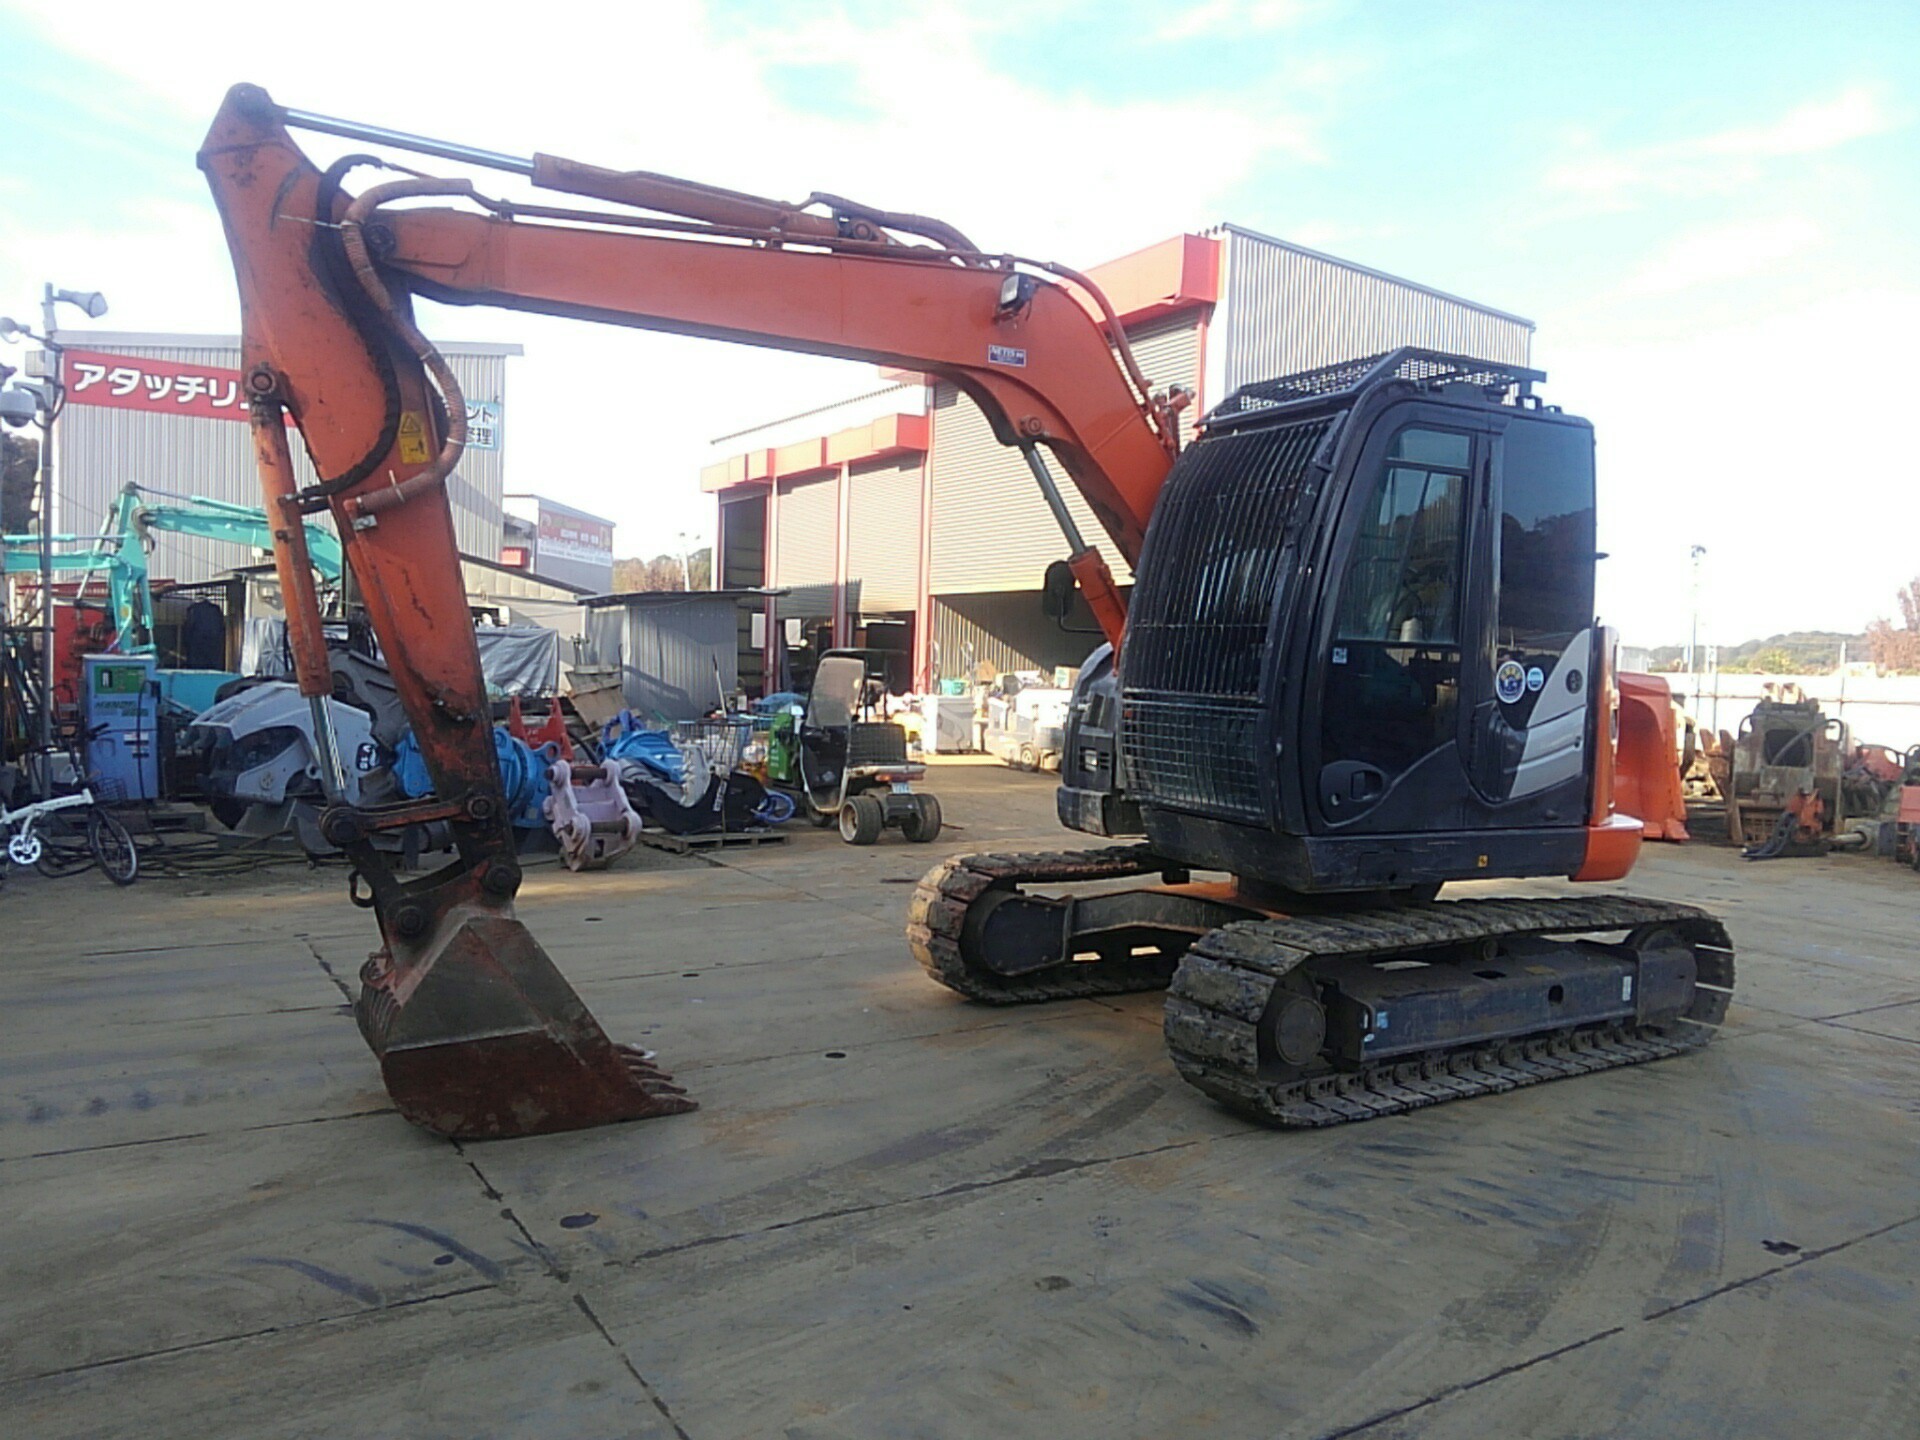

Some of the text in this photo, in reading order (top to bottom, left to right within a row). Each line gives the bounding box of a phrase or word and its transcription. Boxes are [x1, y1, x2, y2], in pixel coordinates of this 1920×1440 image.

[73, 362, 249, 410] アタッチリ
